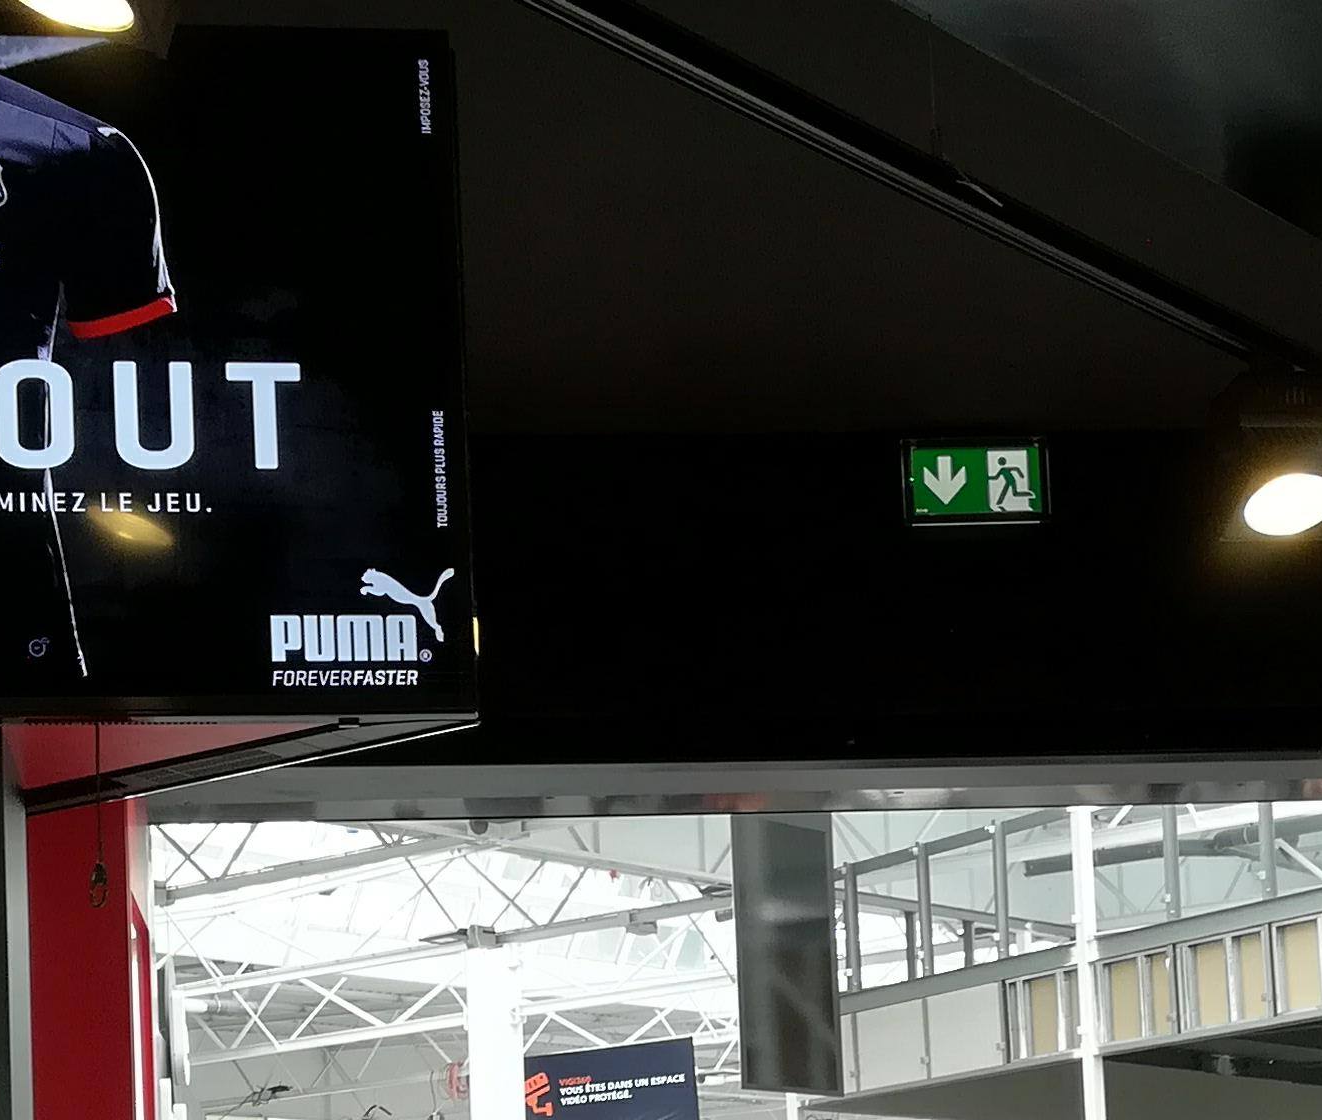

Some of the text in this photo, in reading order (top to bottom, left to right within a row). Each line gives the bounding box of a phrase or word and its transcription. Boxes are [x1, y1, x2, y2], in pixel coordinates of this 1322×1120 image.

[418, 59, 431, 133] IMPOSEZ-VOUS
[432, 410, 448, 528] TOUJOURS PLUS RAPIDE
[101, 492, 134, 512] LE
[147, 492, 213, 513] JEU.
[270, 614, 418, 662] PUMA
[272, 670, 419, 686] FOREVERFASTER
[559, 1085, 584, 1096] VOUS
[607, 1079, 633, 1090] DANS
[635, 1077, 649, 1087] UN
[650, 1073, 686, 1086] ESPACE
